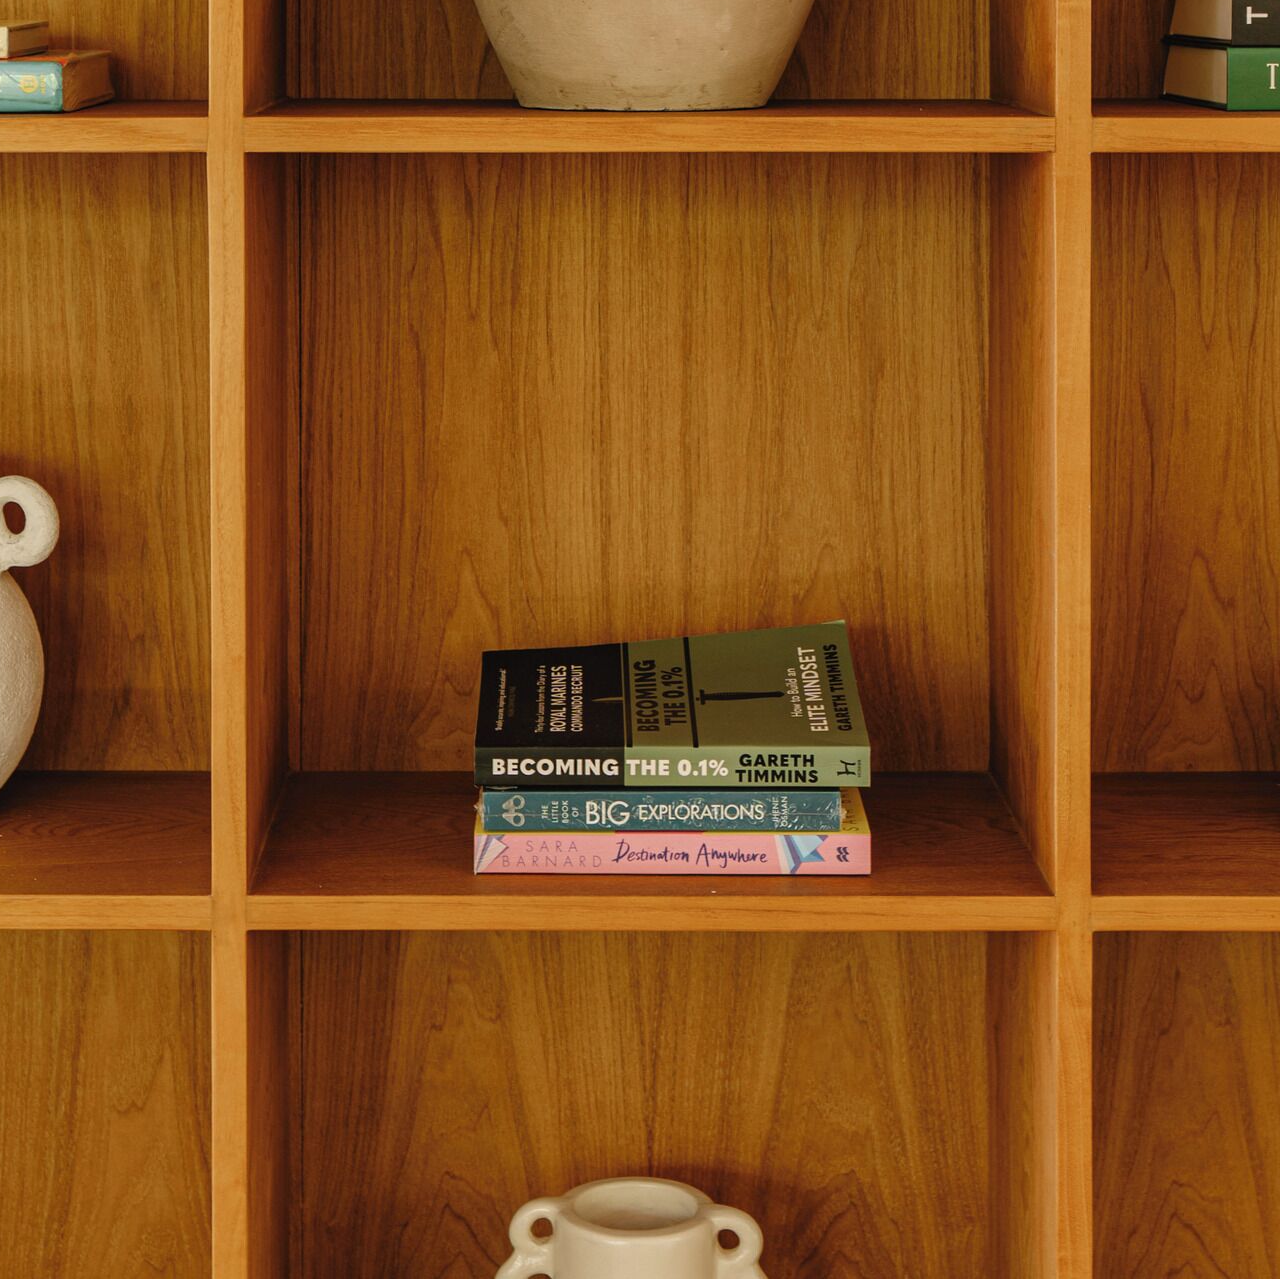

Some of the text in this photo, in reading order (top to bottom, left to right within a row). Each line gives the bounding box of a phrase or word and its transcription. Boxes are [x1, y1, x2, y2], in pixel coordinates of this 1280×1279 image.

[787, 667, 797, 677] an
[634, 659, 660, 732] BECOMING
[660, 666, 687, 726] THE 0.1%
[785, 678, 799, 695] Build
[797, 647, 829, 732] ELITE MINDSET
[823, 643, 853, 731] GARETH TIMMINS
[550, 665, 567, 732] ROYAL MARINES
[571, 665, 583, 732] COMMANDO RECRUIT
[790, 703, 803, 718] How
[492, 758, 730, 777] BECOMING THE 0.1%
[739, 754, 815, 768] GARETH
[735, 769, 819, 783] TIMMINS
[541, 804, 549, 820] THE
[551, 800, 559, 823] LITTLE
[561, 800, 569, 824] BOOK
[572, 806, 579, 818] OF
[586, 801, 766, 825] BIG EXPLORATIONS
[780, 795, 789, 827] OSMAN
[525, 840, 579, 853] SARA
[612, 838, 769, 869] Destination Anywhere
[502, 855, 603, 868] BARNARD
